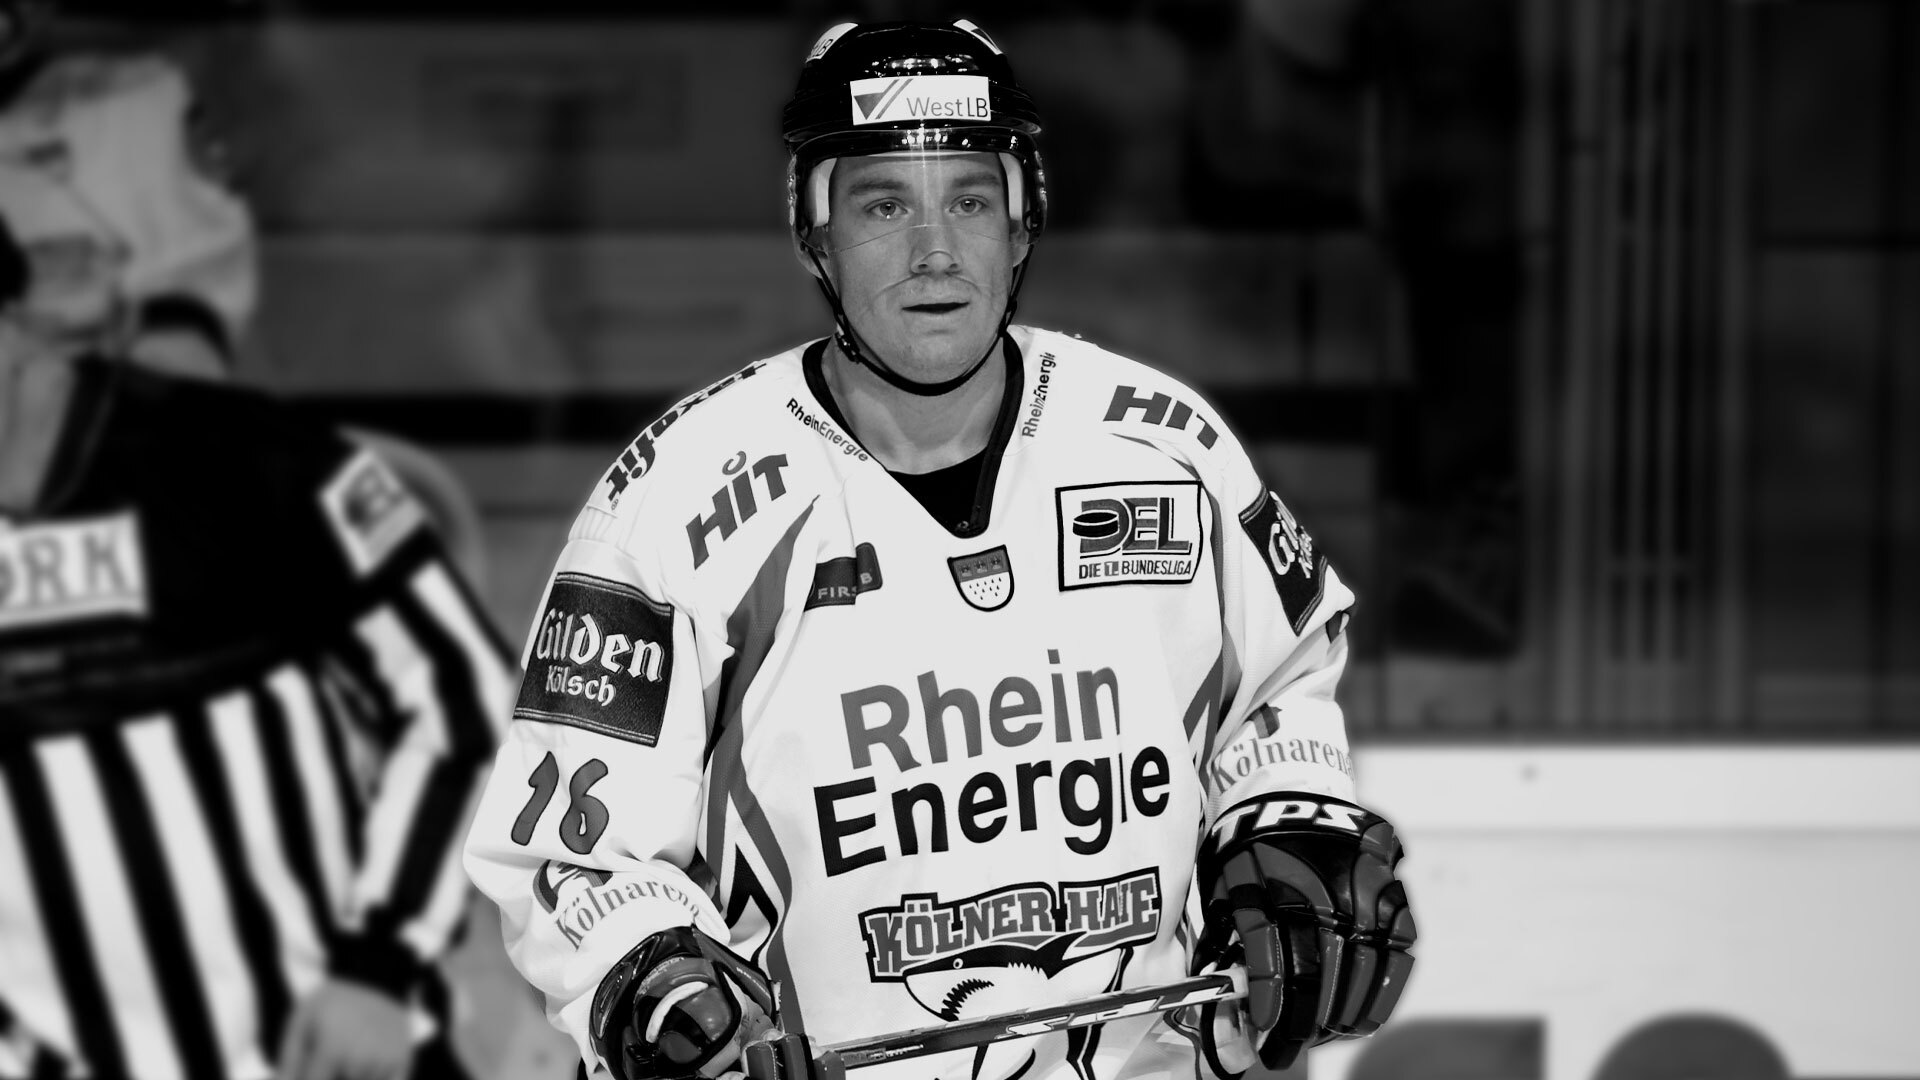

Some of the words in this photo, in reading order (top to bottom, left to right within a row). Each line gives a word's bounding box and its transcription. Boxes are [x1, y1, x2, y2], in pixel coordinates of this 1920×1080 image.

[906, 97, 989, 118] WestLB
[786, 397, 869, 462] RheinEnergie
[1102, 385, 1219, 450] HIT
[685, 453, 789, 571] HIT
[1078, 497, 1193, 559] DEL
[1079, 563, 1102, 580] DIE
[1121, 560, 1192, 575] BUNDESLIGA
[536, 607, 664, 683] Gilden
[545, 664, 617, 707] Kölsch
[840, 648, 1121, 773] Rhein
[511, 750, 610, 855] 16
[813, 745, 1171, 878] Energie
[1210, 800, 1369, 855] TPS
[867, 890, 1052, 974] KÖLNER
[1066, 876, 1158, 933] HAIE
